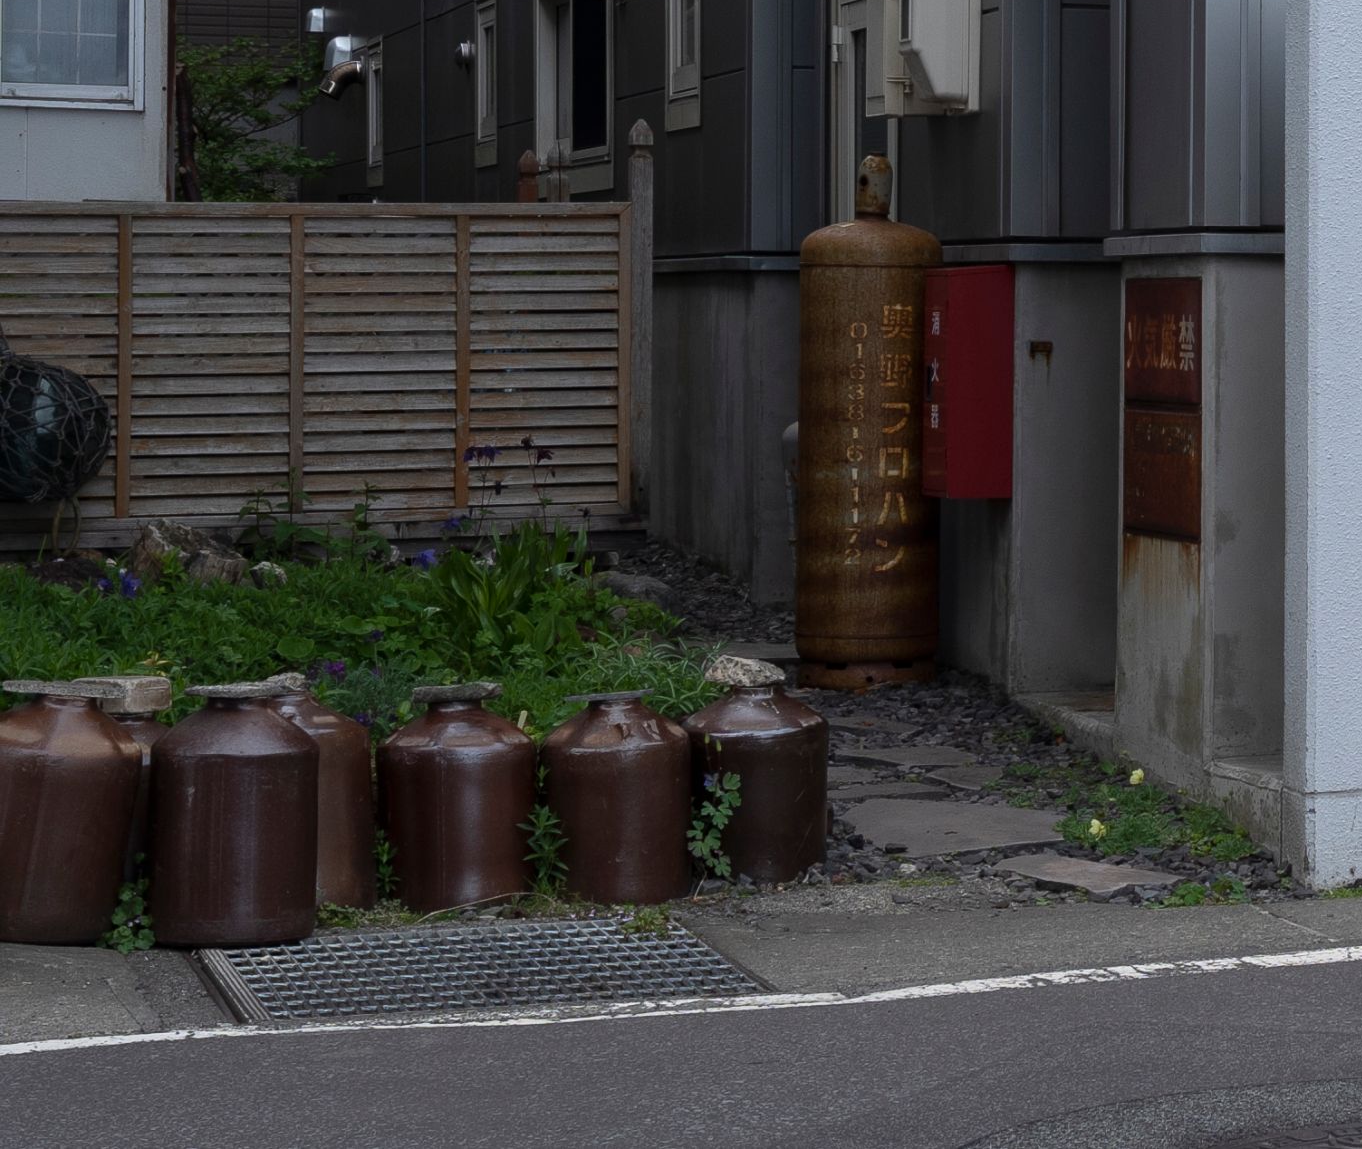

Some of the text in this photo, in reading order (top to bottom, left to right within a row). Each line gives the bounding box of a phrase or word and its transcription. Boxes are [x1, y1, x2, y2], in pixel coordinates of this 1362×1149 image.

[930, 311, 941, 429] 消火器
[1126, 313, 1196, 371] 火気厳禁
